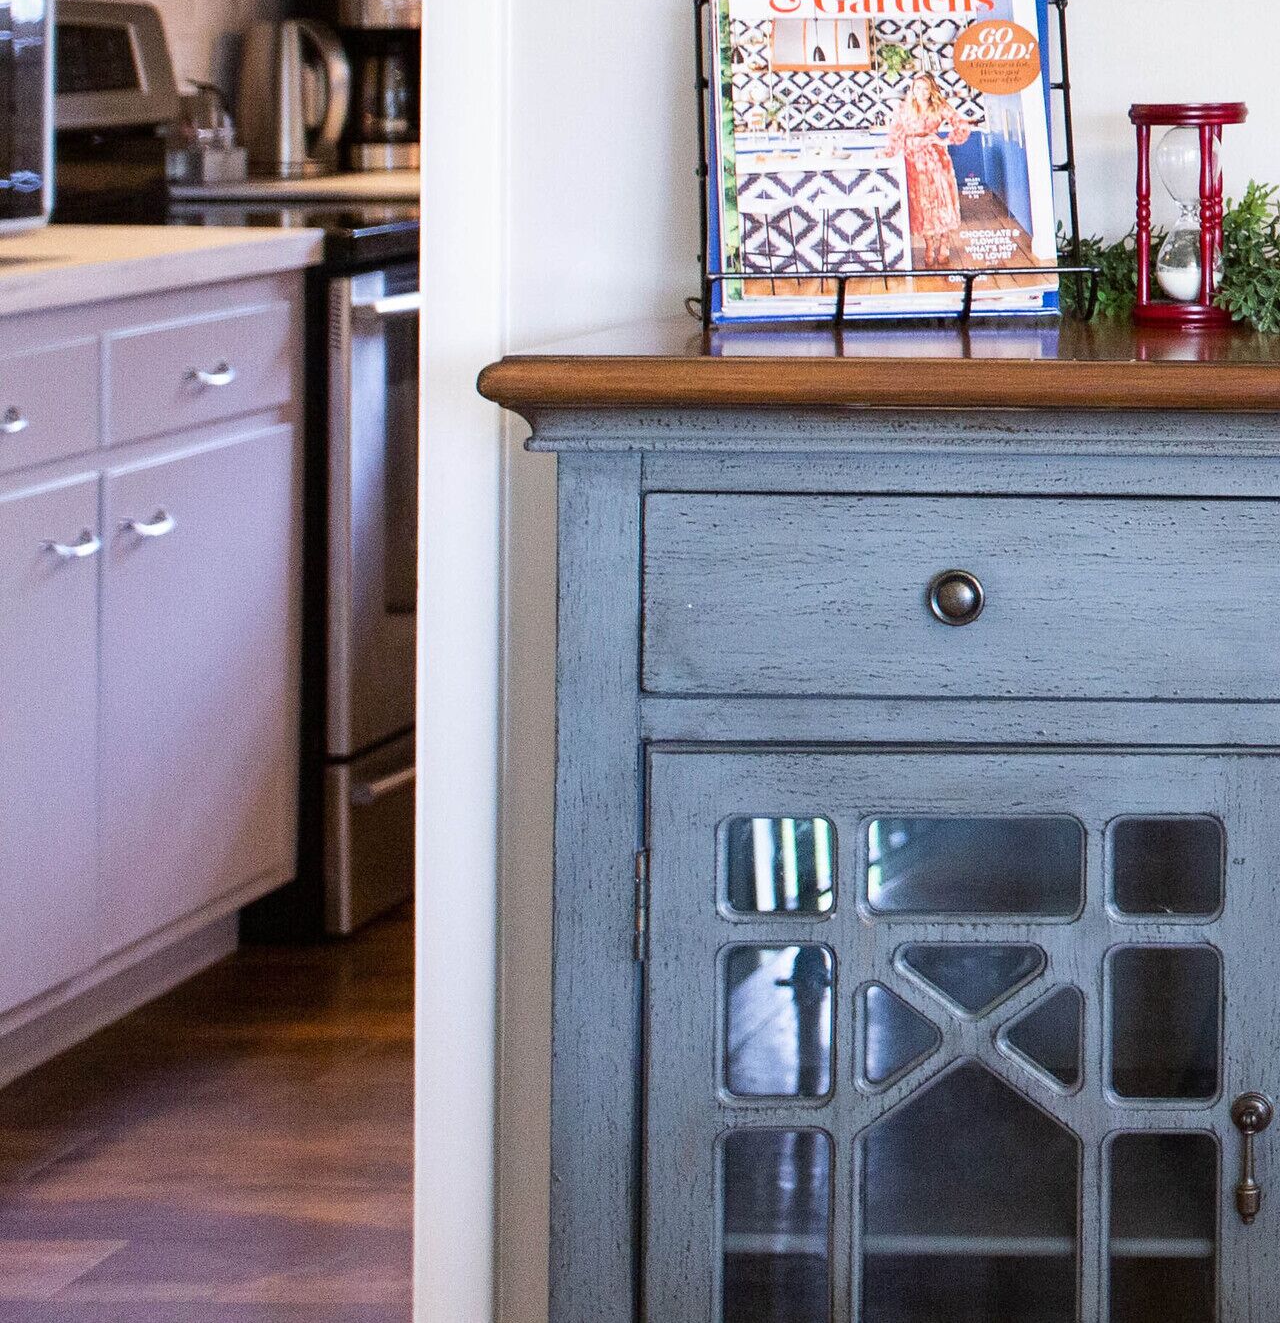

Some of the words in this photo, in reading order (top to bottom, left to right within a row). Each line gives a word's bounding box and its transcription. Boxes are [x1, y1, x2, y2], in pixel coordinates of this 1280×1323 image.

[979, 27, 1013, 44] GO
[959, 42, 1035, 62] BOLD!
[960, 229, 1011, 238] CHOCOLATE
[999, 243, 1018, 252] NOT
[972, 252, 985, 260] TO
